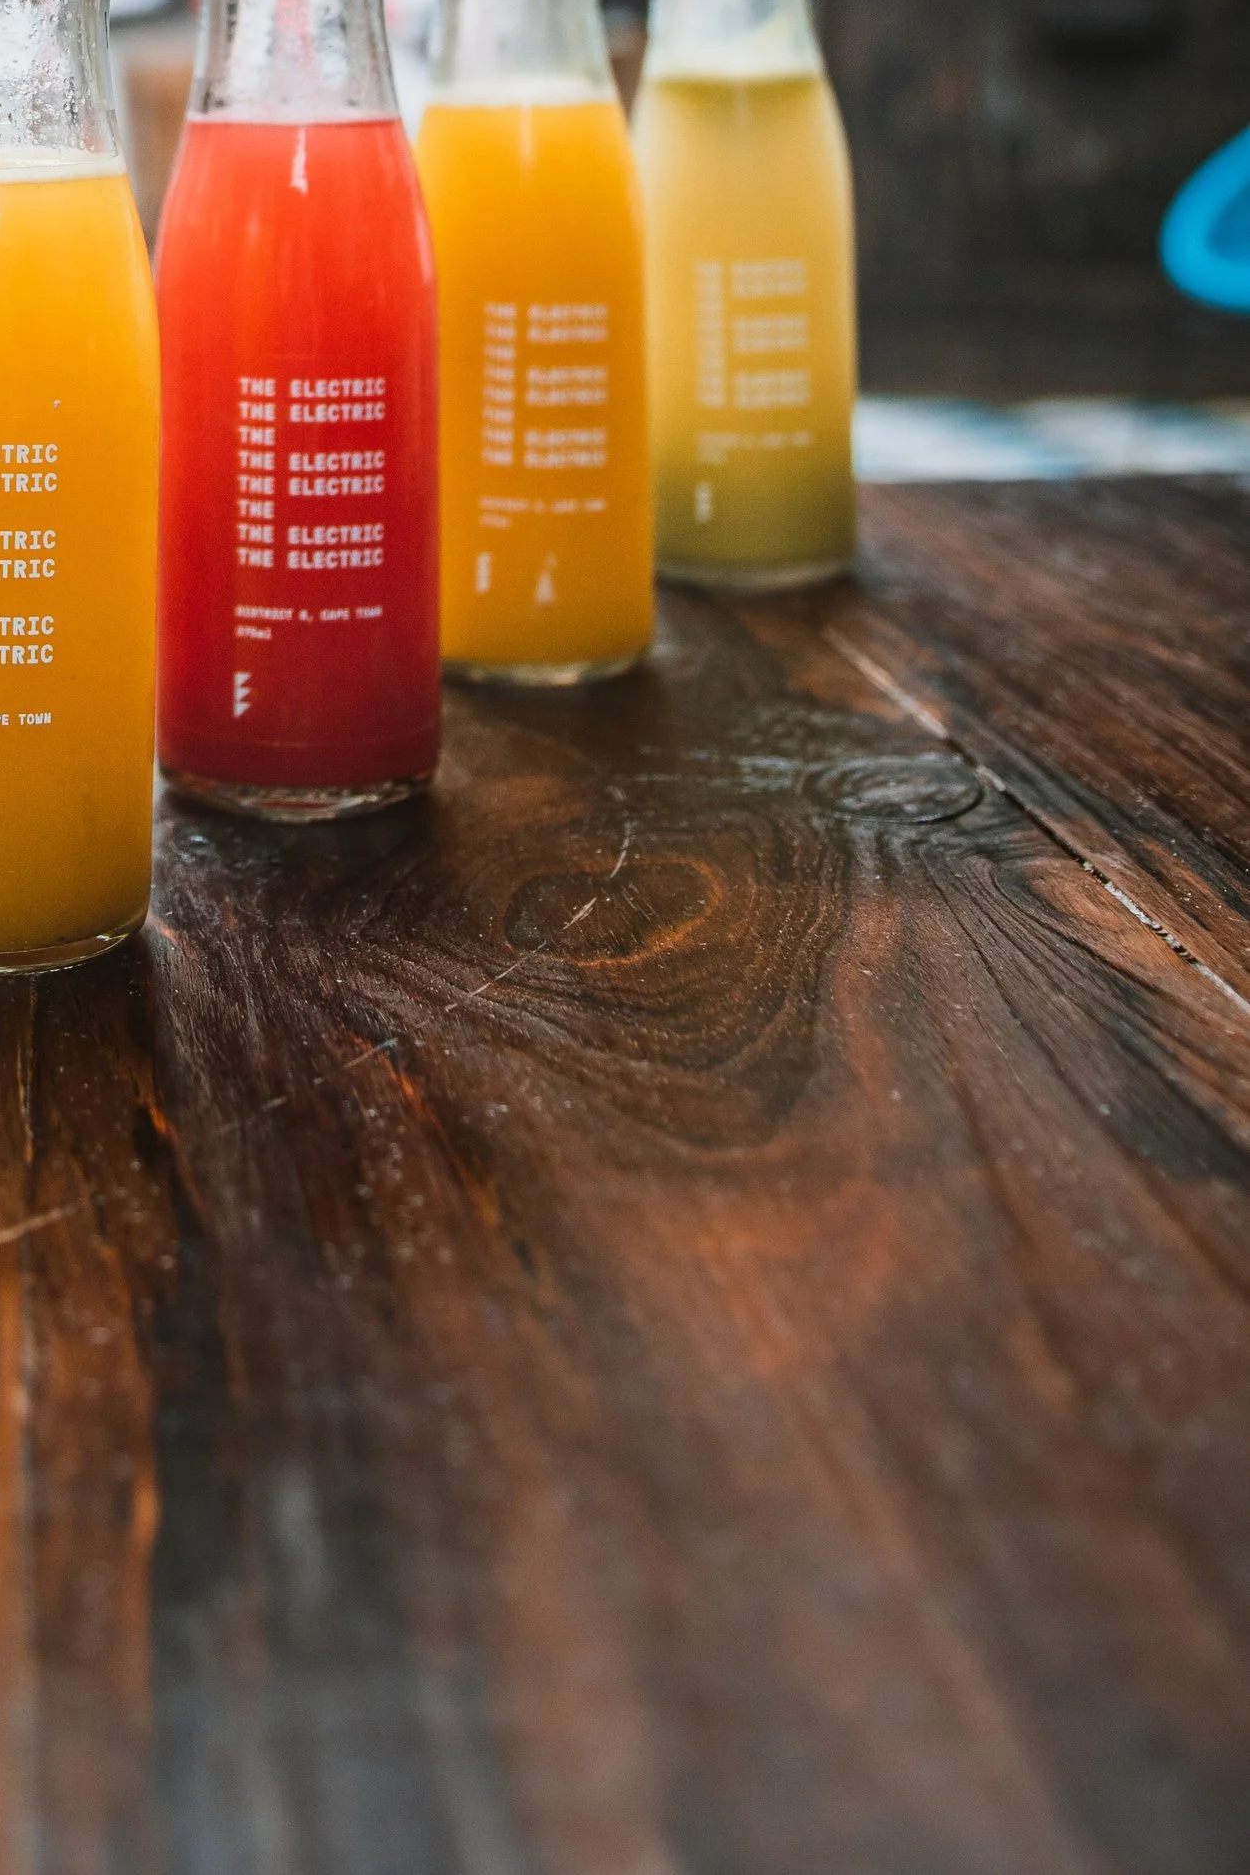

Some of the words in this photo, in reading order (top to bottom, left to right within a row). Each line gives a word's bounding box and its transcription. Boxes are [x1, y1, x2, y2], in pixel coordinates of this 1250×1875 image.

[239, 377, 276, 397] THE
[290, 378, 385, 398] ELECTRIC
[238, 401, 275, 421] THE
[289, 402, 385, 423] ELECTRIC
[238, 425, 275, 446] THE
[238, 450, 275, 471] THE
[289, 451, 384, 472] ELECTRIC
[238, 474, 274, 494] THE
[289, 475, 384, 496] ELECTRIC
[237, 499, 274, 519] THE
[237, 523, 274, 543] THE
[288, 524, 383, 545] ELECTRIC
[237, 547, 274, 568] THE
[287, 548, 383, 569] ELECTRIC
[18, 713, 52, 725] TOWN
